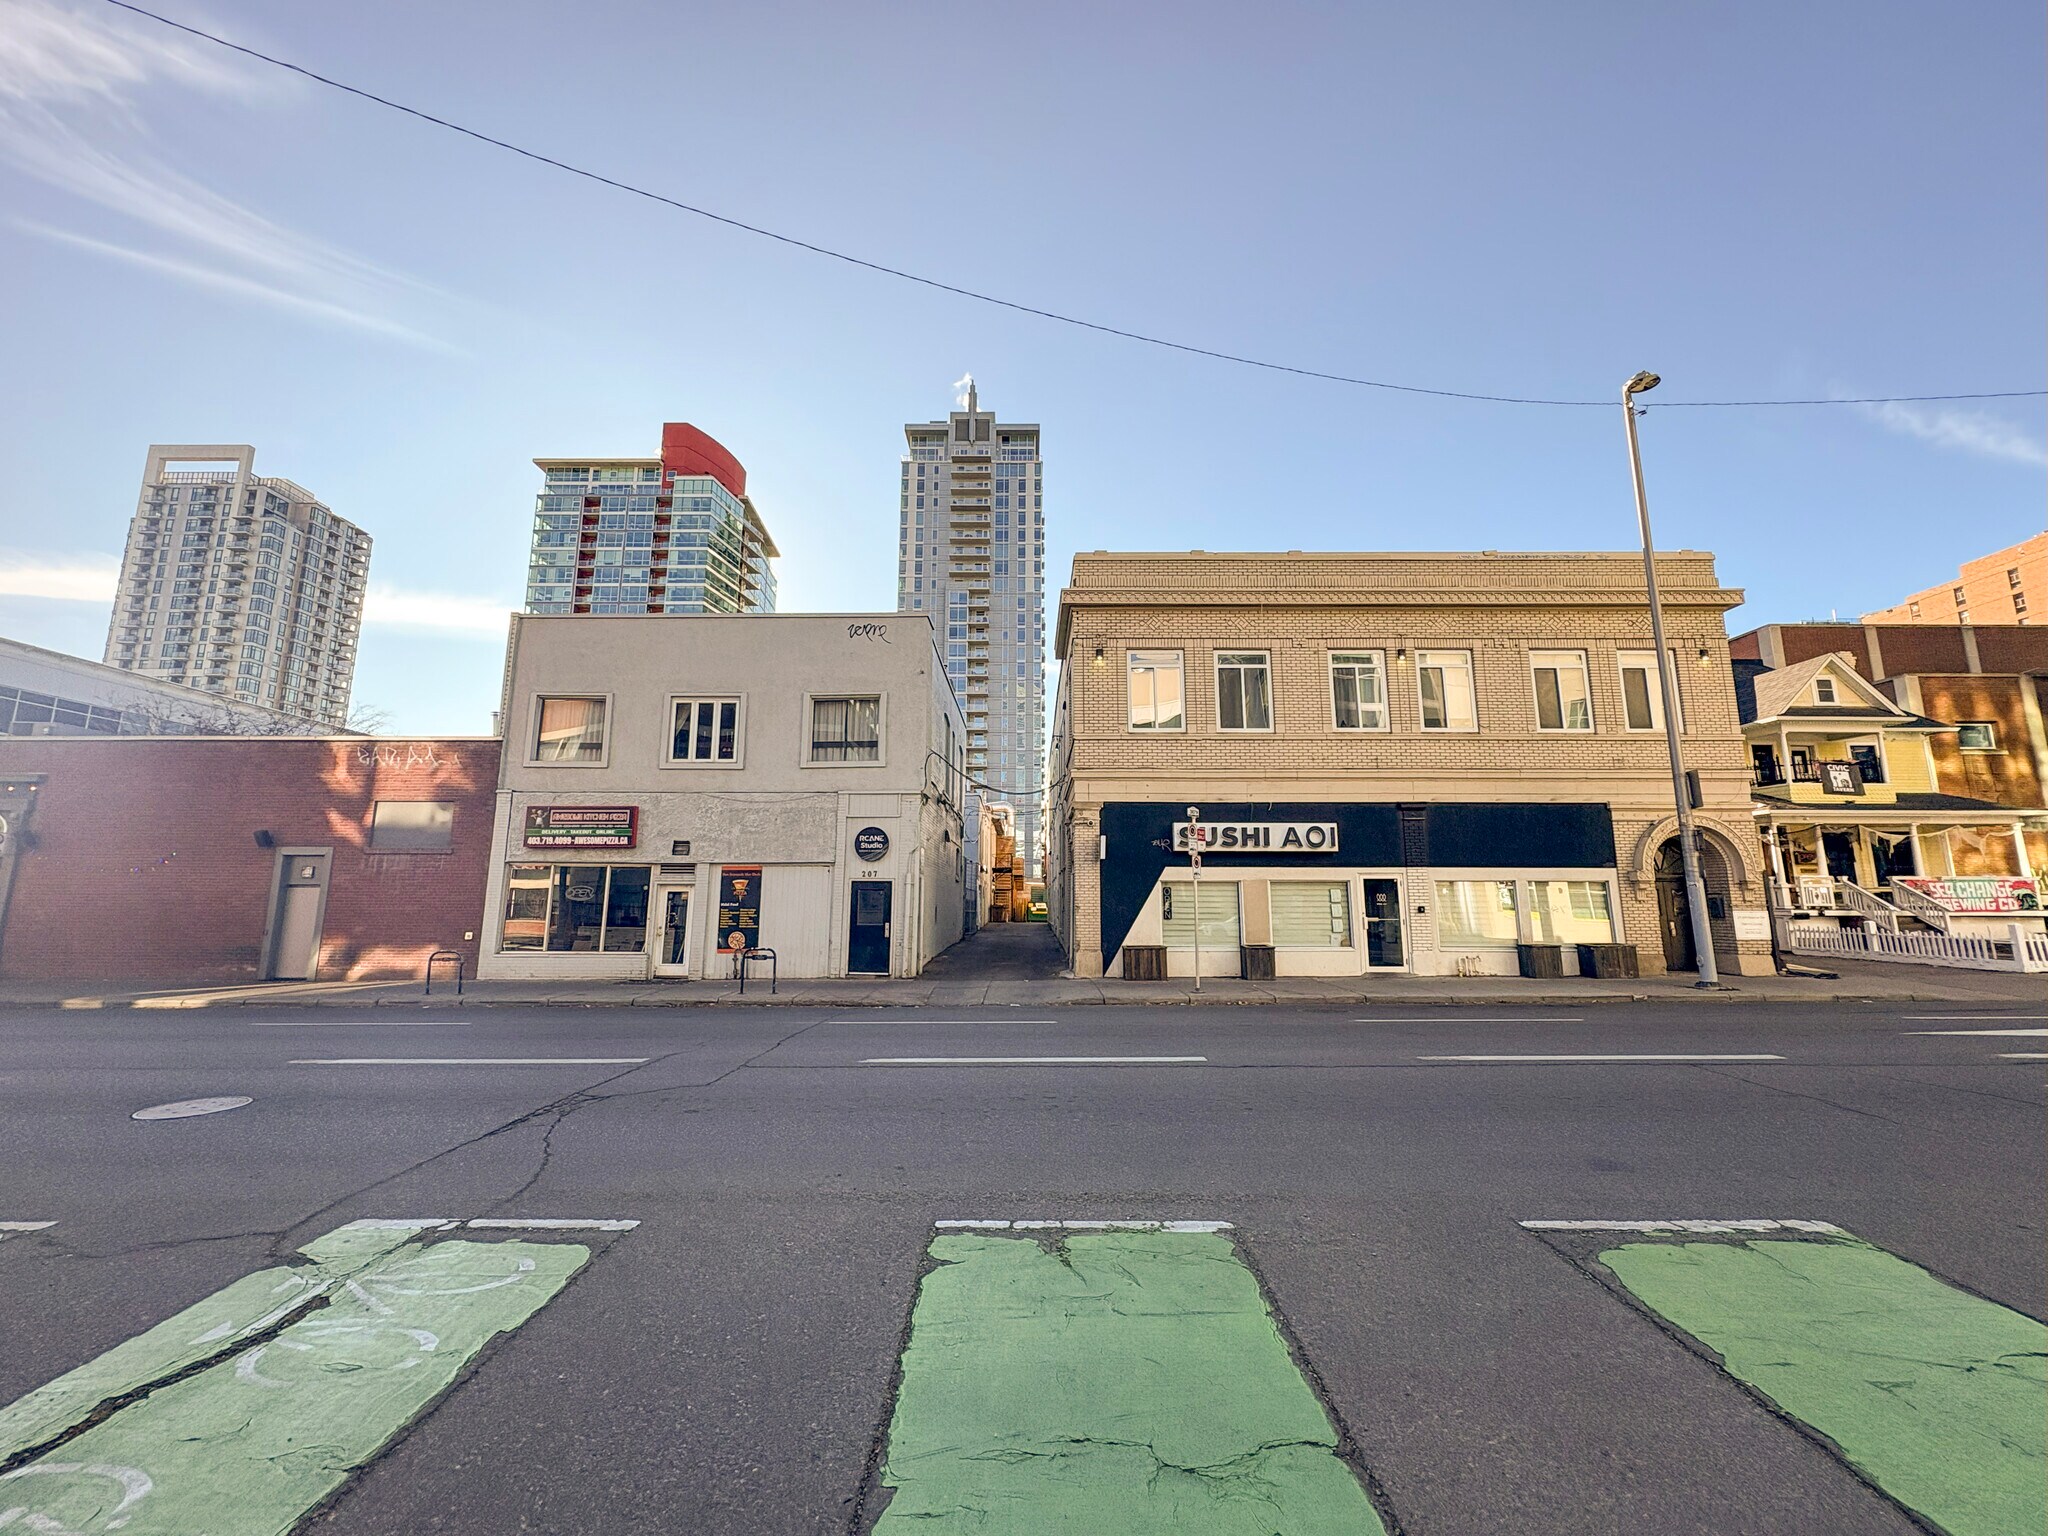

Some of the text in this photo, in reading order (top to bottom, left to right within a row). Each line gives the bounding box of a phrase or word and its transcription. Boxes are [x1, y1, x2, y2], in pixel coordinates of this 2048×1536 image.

[1281, 826, 1336, 848] AOI
[861, 870, 878, 878] 207
[1929, 882, 1955, 898] SEA
[1163, 887, 1172, 919] OPEN
